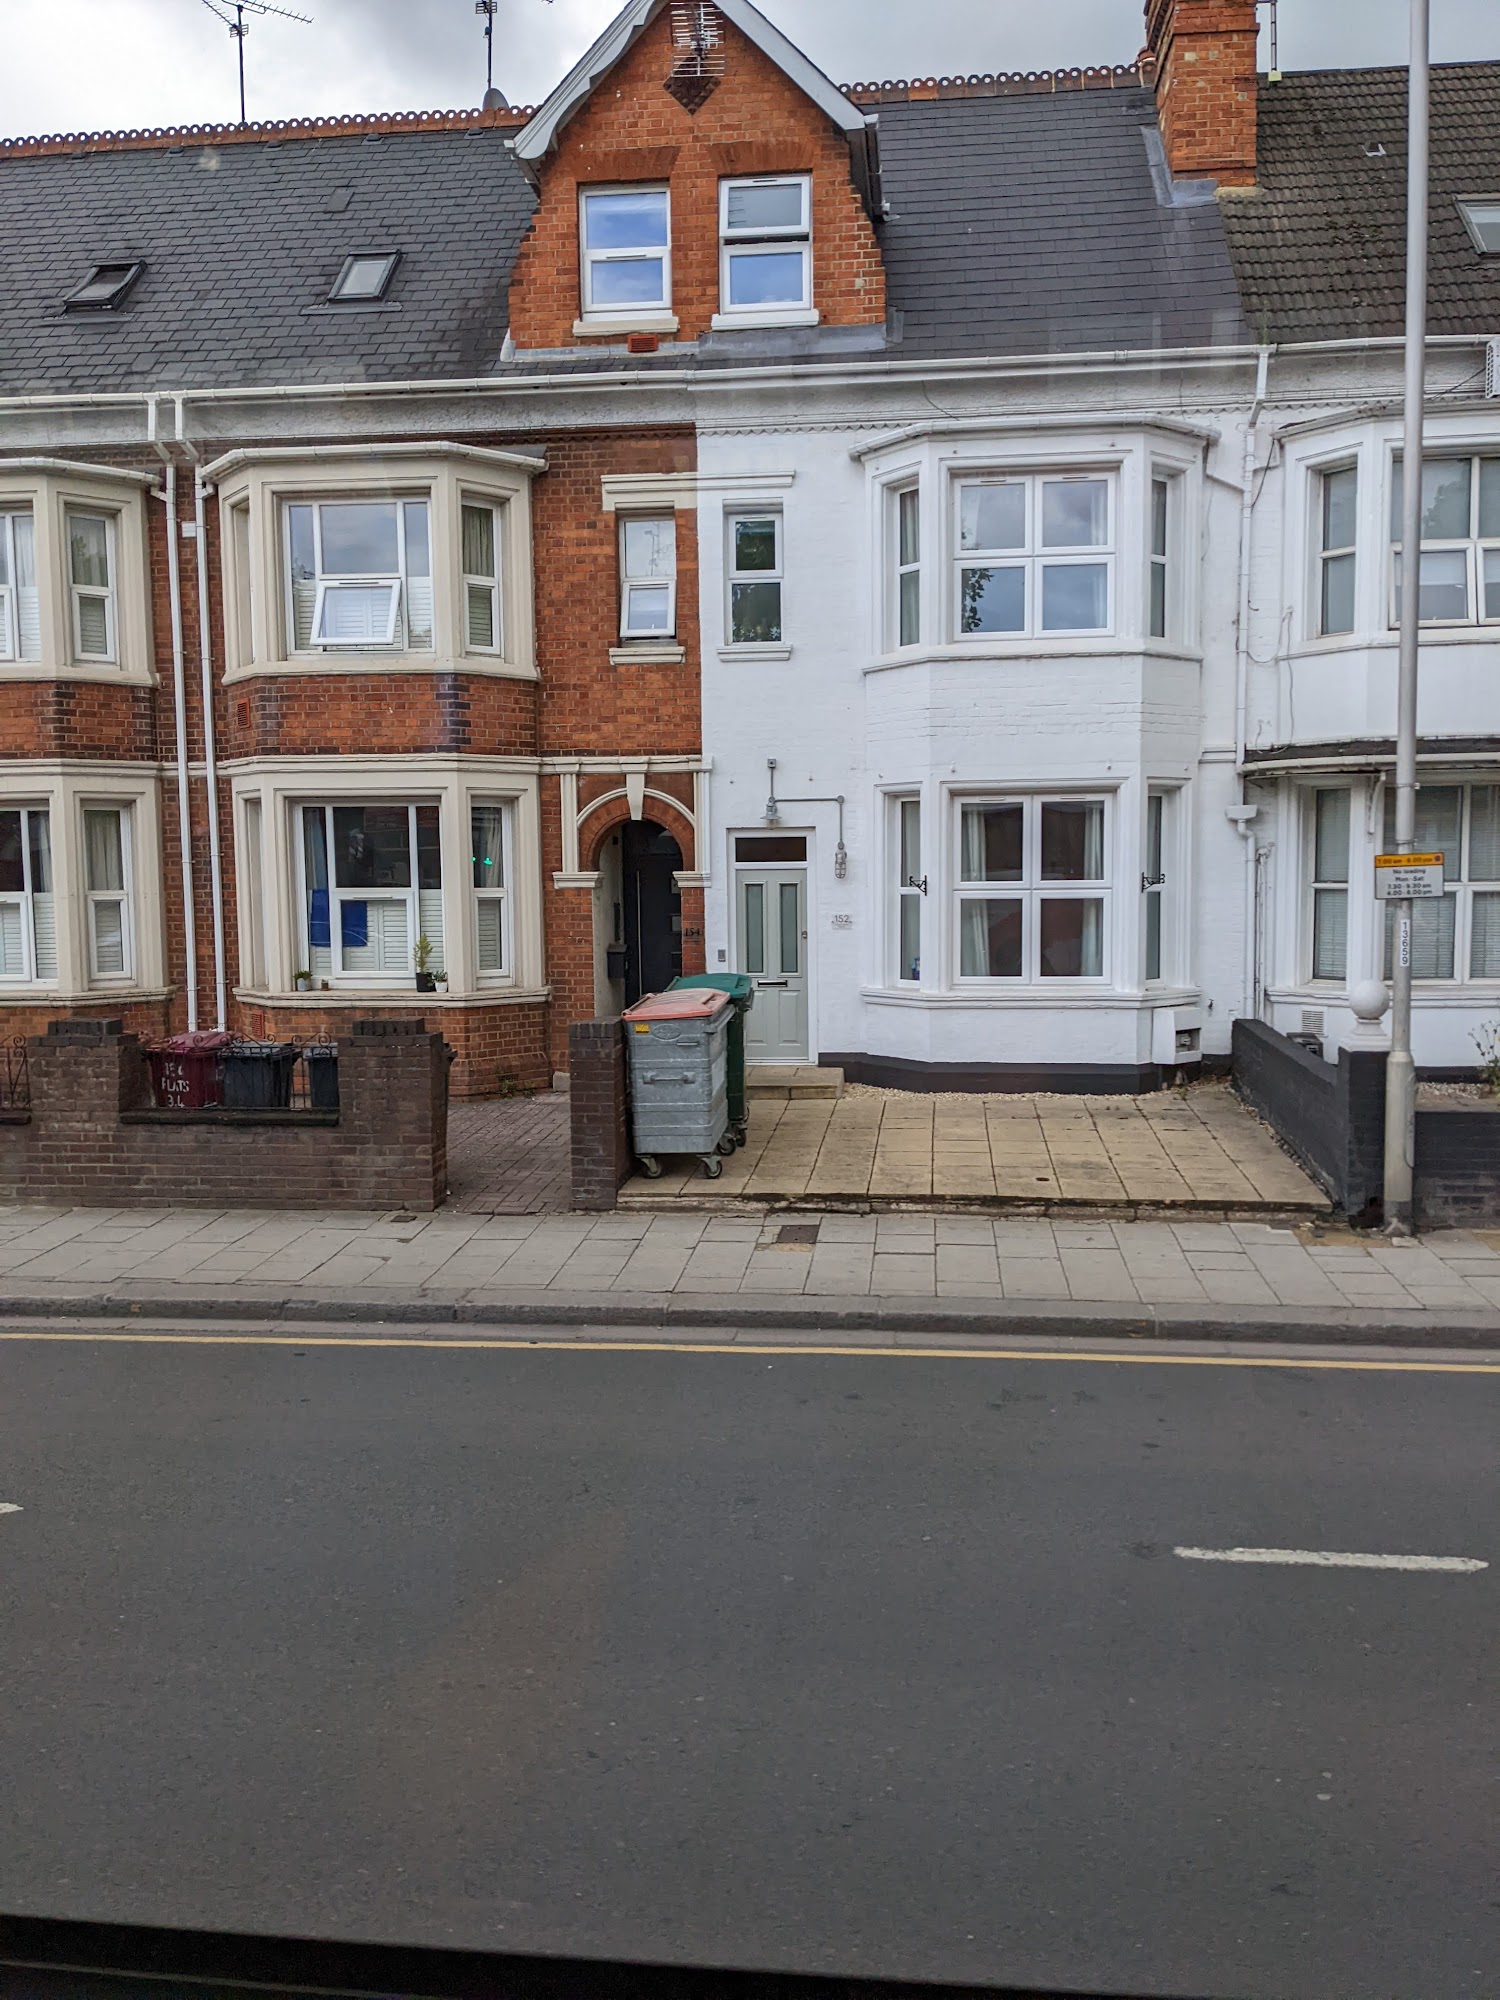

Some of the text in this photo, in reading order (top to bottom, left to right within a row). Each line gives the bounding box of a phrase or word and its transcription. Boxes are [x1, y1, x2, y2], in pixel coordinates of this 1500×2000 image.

[834, 914, 849, 923] 152
[685, 927, 701, 937] 154
[1401, 921, 1409, 965] 13659
[161, 1077, 190, 1092] FLATS
